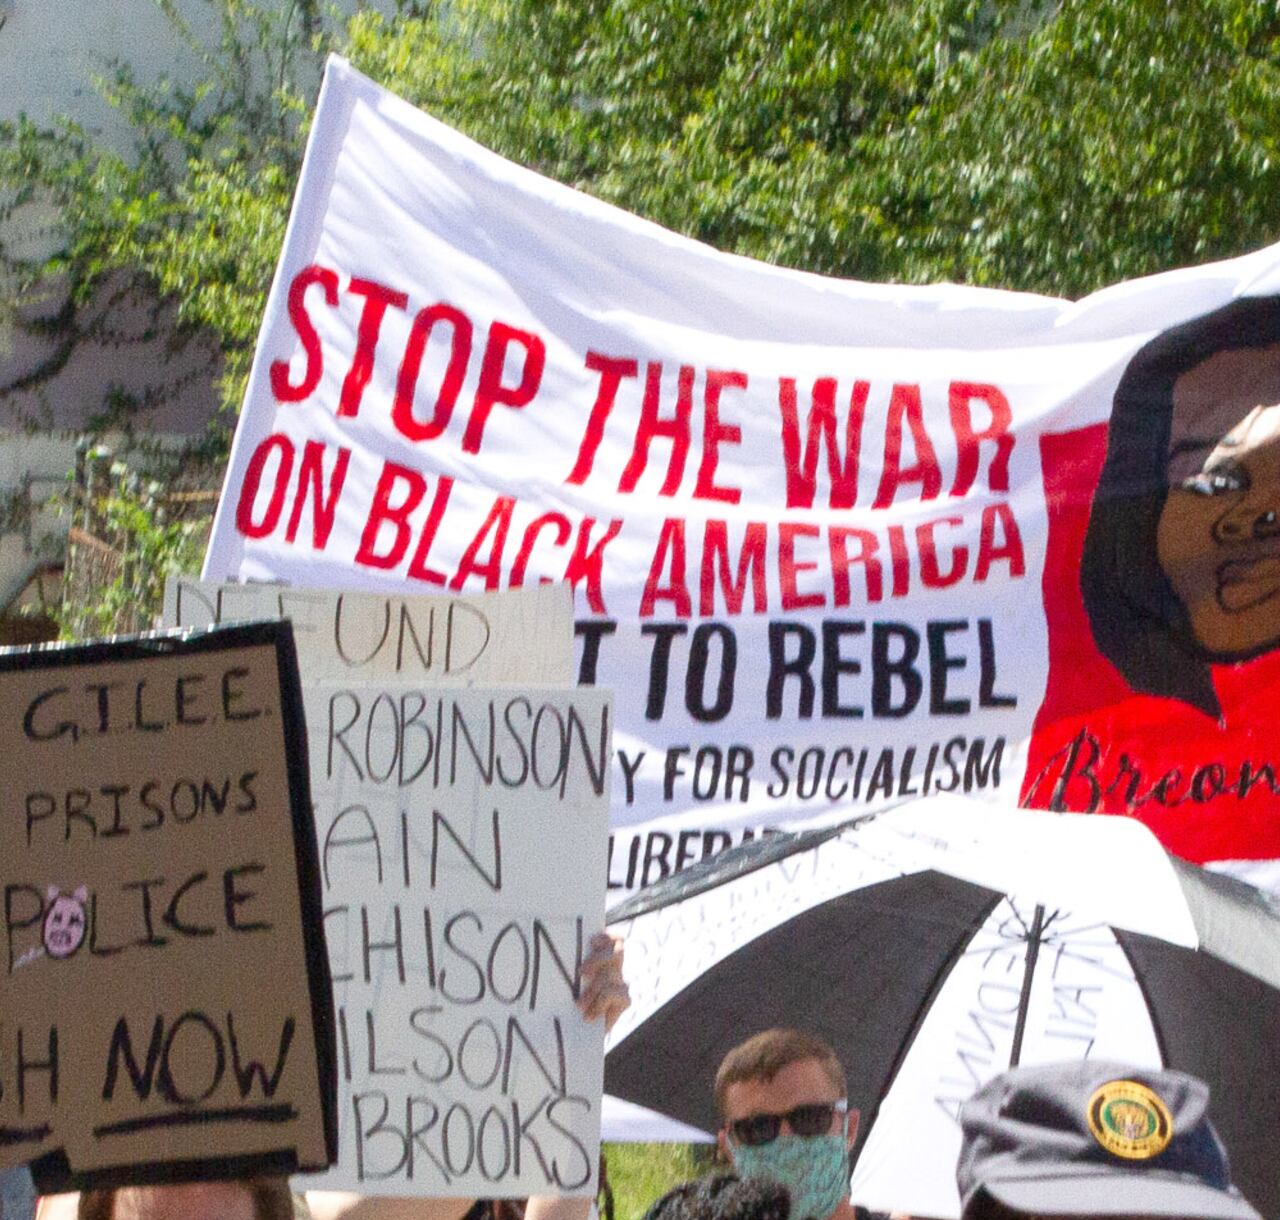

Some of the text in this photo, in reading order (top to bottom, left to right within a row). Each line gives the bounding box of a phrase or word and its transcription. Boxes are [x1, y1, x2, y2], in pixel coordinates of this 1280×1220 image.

[270, 264, 1017, 512] STOP THE WAR
[235, 432, 1029, 618] ON BLACK AMERICA
[641, 621, 738, 723] TO
[765, 617, 1019, 721] REBEL
[326, 689, 609, 800] ROBINSON
[663, 745, 755, 804] FOR
[766, 736, 1008, 803] SOCIALISM
[26, 771, 259, 849] PRISONS
[324, 804, 502, 892] AIN
[323, 904, 584, 1012] CHISON
[102, 1012, 296, 1102] NOW
[338, 1005, 567, 1098] ILSON
[353, 1089, 593, 1192] BROOKS
